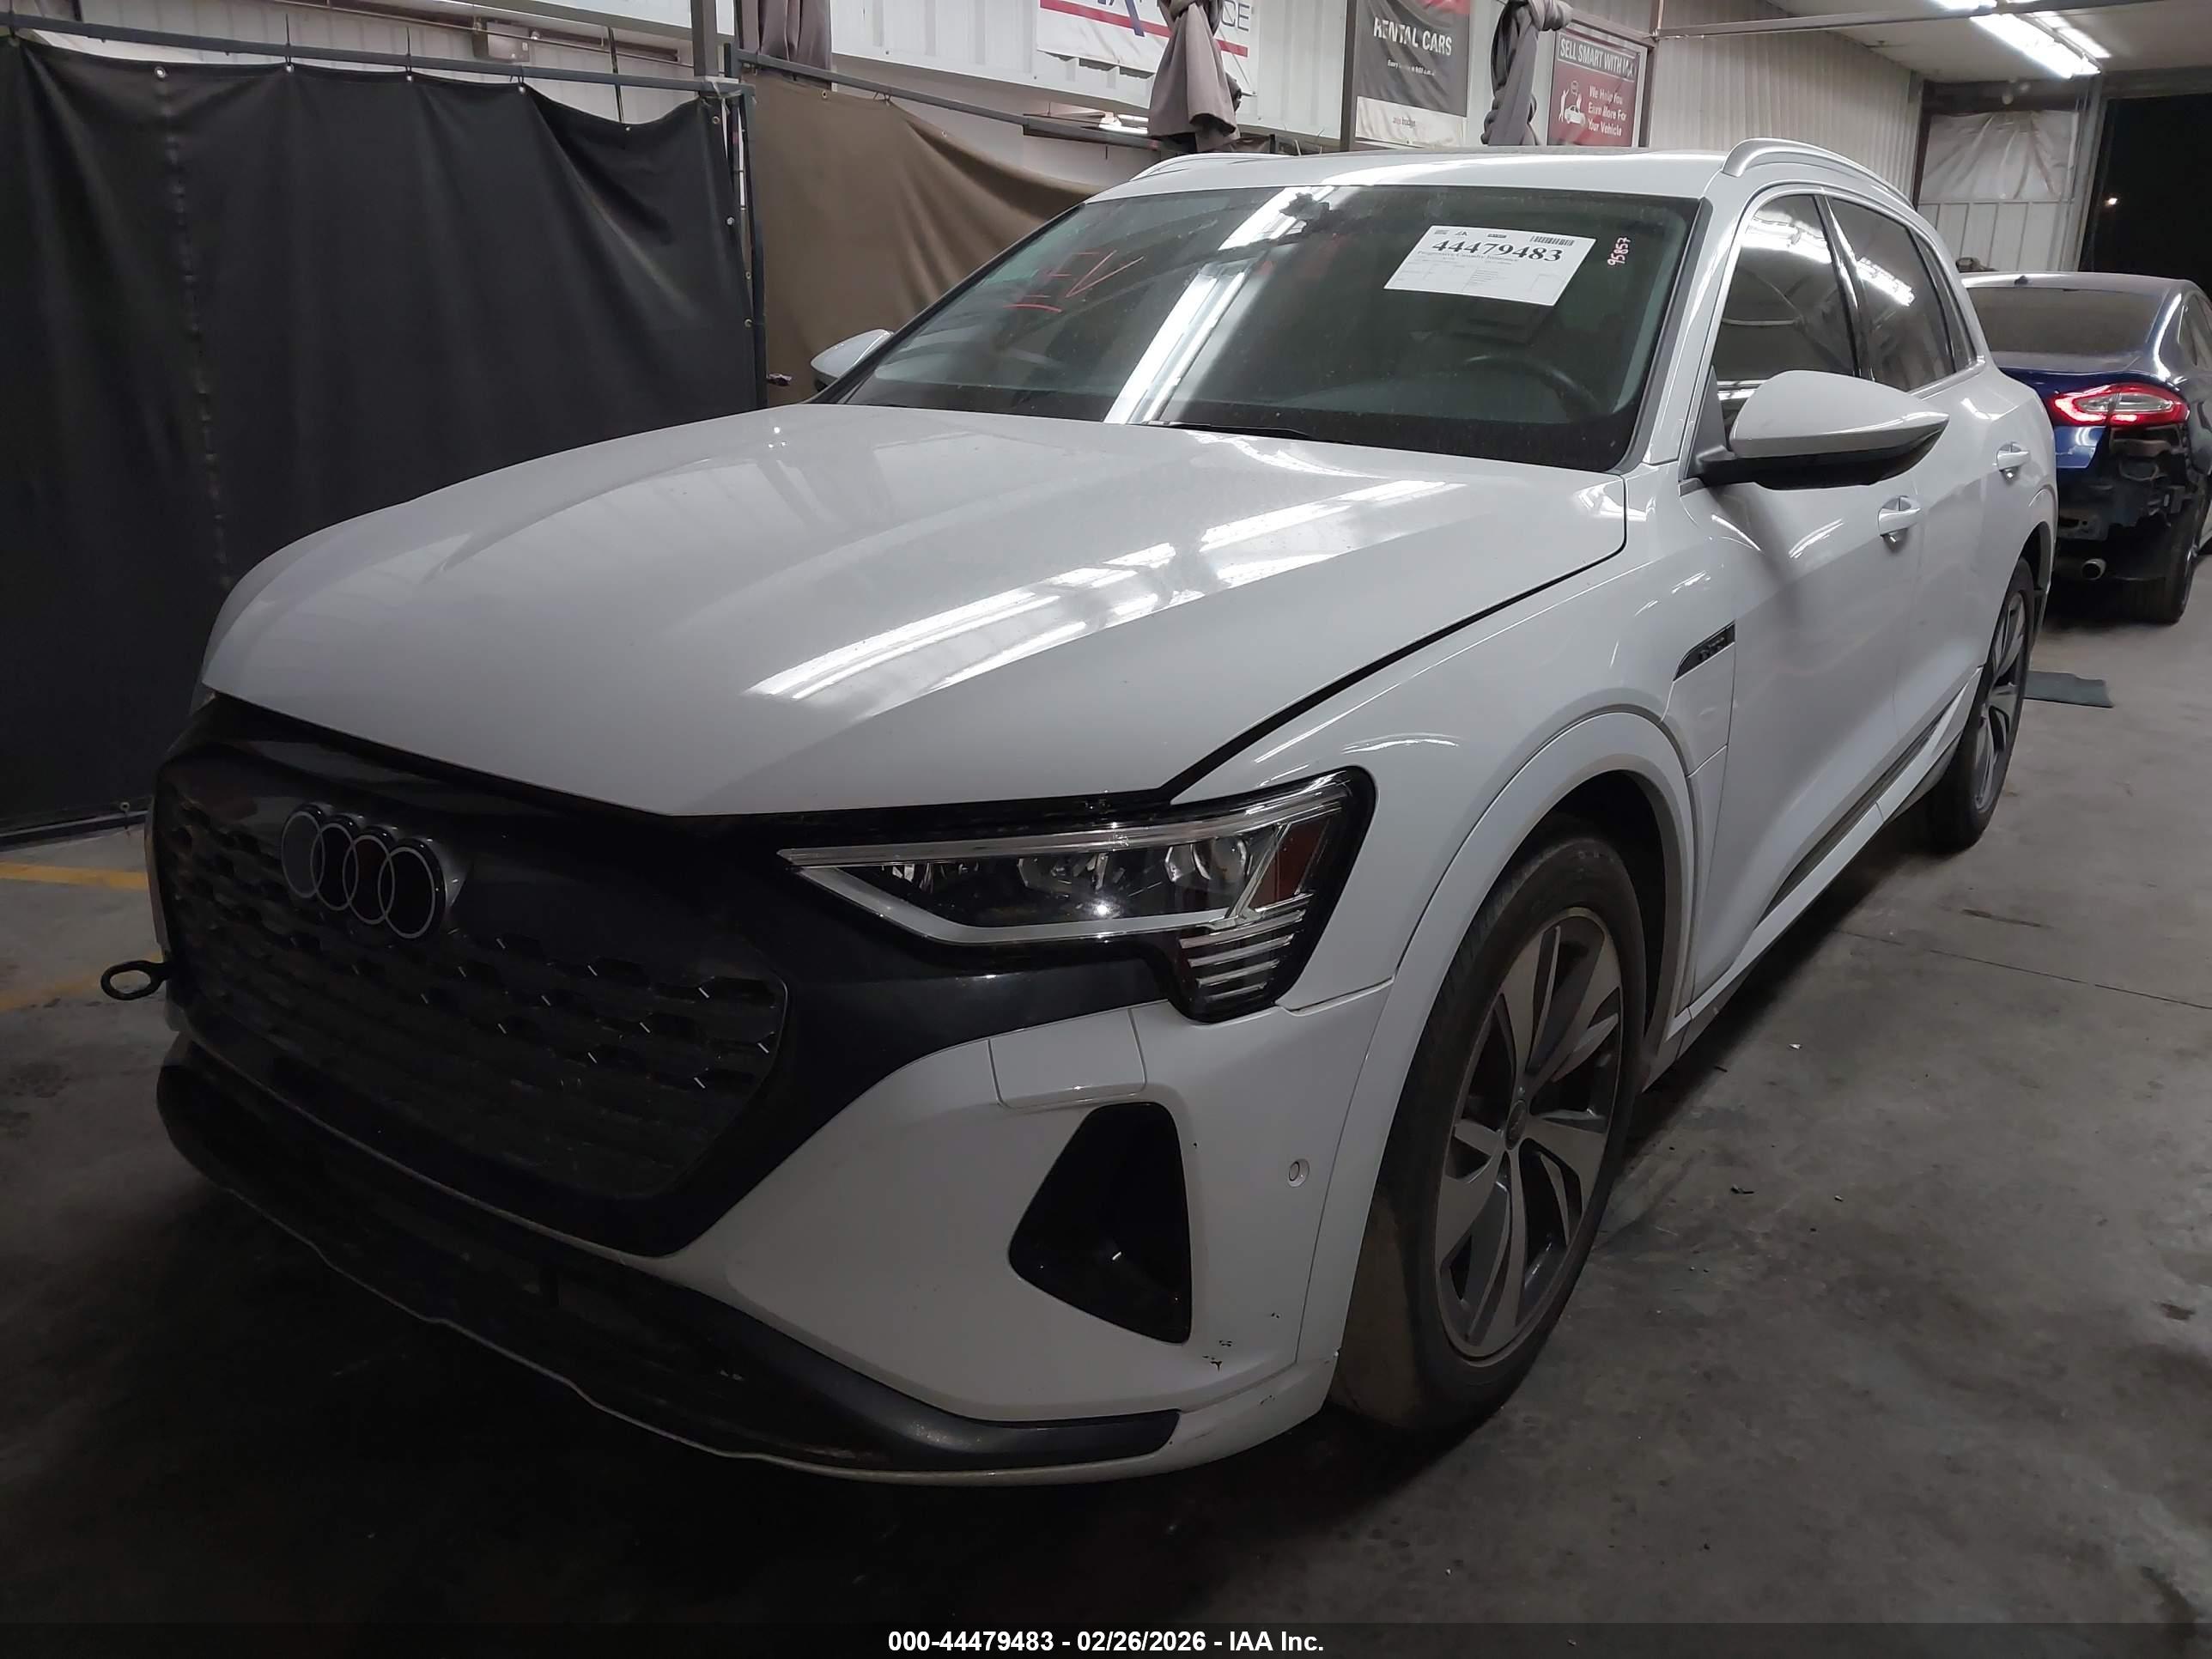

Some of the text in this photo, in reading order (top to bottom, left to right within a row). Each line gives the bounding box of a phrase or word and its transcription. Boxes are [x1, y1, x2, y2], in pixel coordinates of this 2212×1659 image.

[1374, 17, 1452, 56] RENTAL CARS
[1560, 39, 1577, 60] SELL
[1578, 45, 1603, 68] SMART
[1604, 52, 1622, 74] WITH
[1589, 85, 1599, 99] We
[1588, 101, 1627, 121] Earn More For
[1588, 118, 1622, 137] Your Vehicle
[1432, 240, 1564, 261] 44479483
[1607, 237, 1632, 266] 95857
